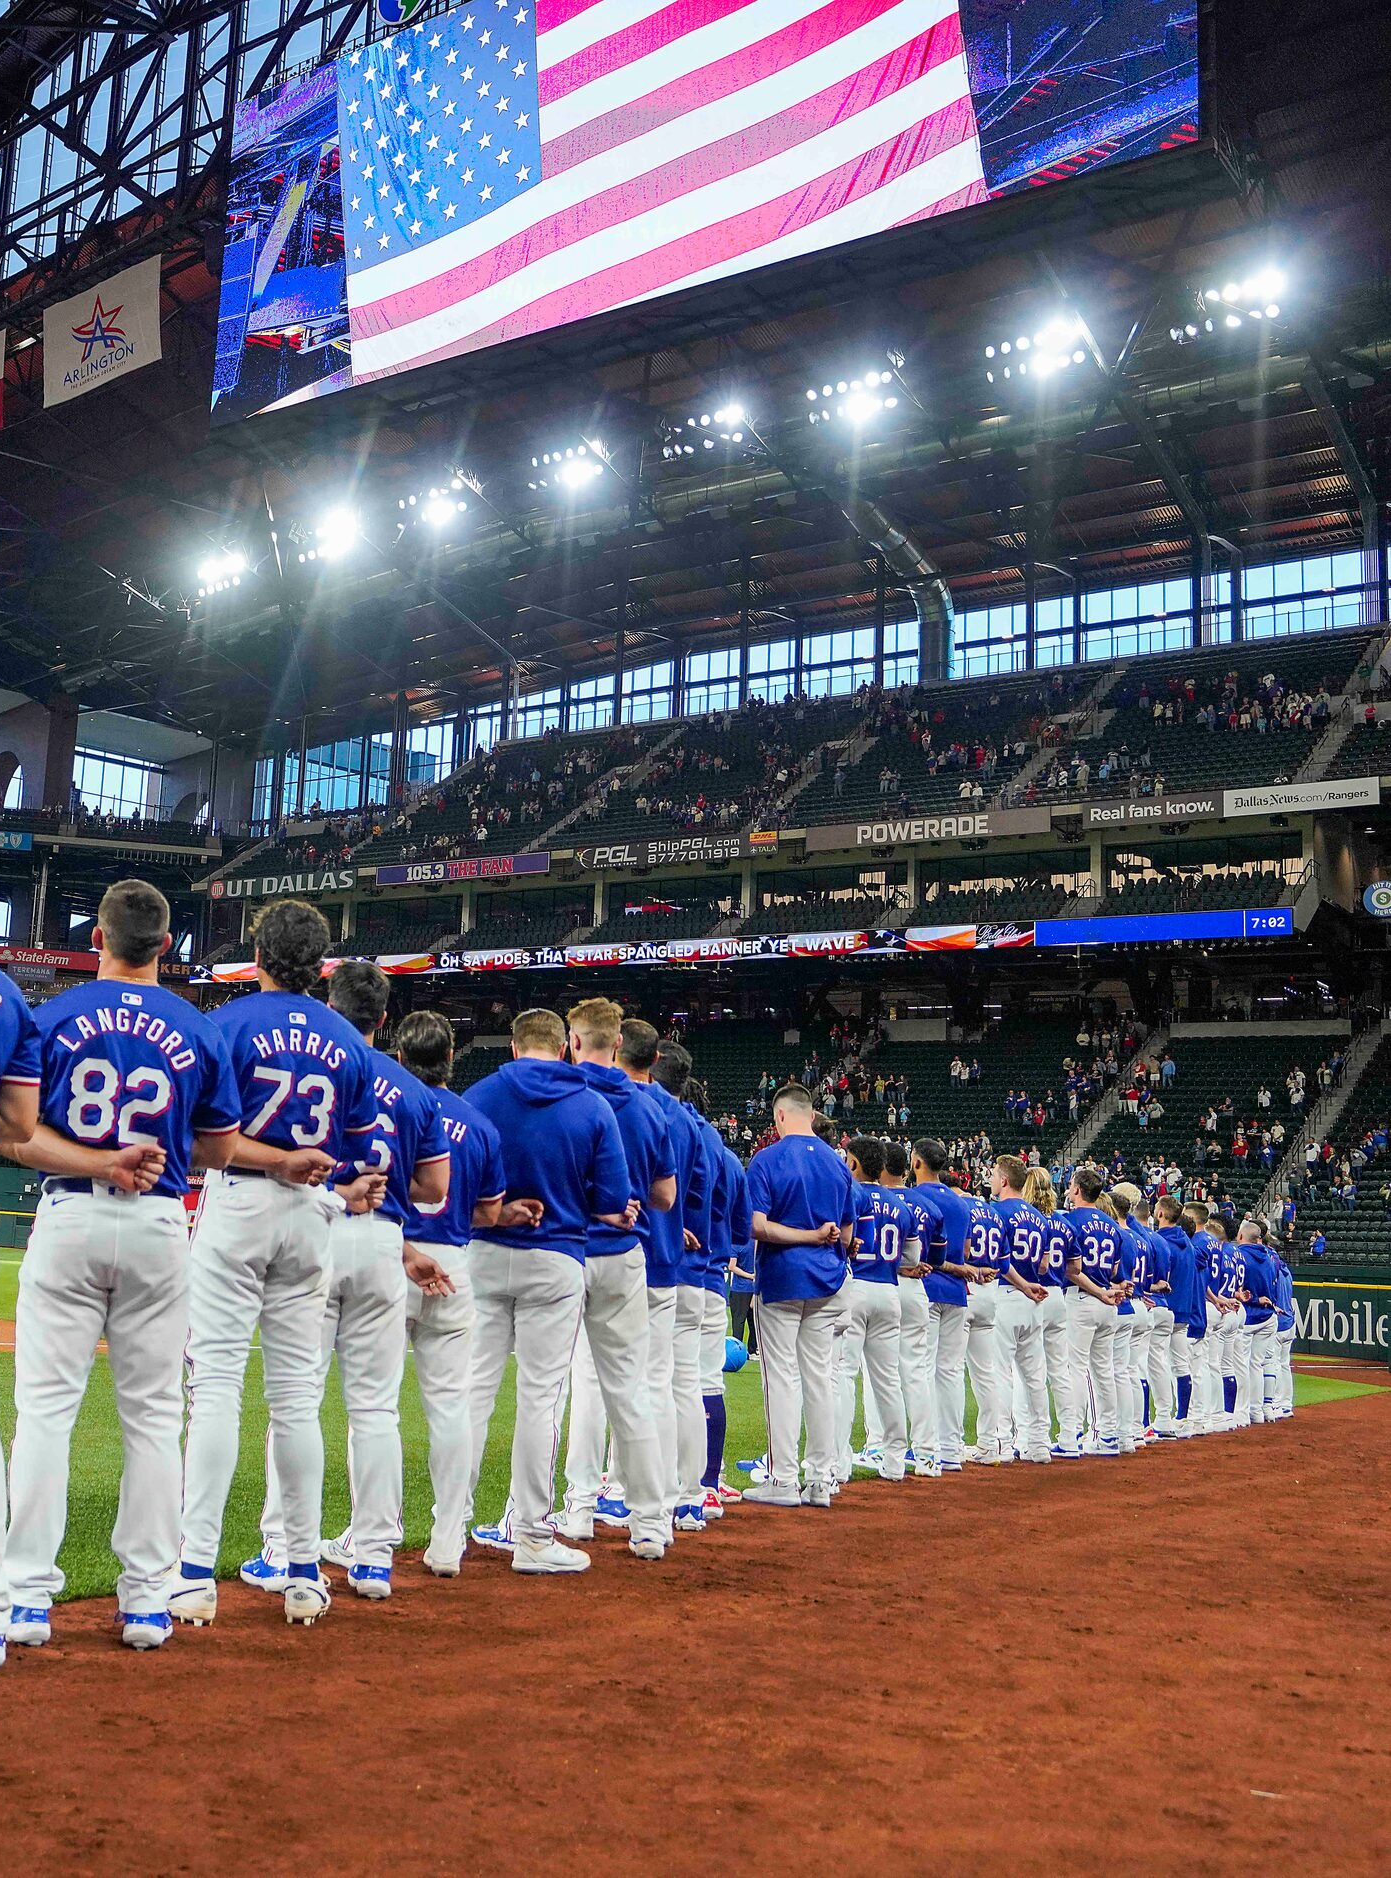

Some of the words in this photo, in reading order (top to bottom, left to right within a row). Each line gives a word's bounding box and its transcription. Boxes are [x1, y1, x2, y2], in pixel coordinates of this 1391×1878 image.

[63, 343, 134, 386] ARLINGTON
[1090, 805, 1124, 822] Real
[1127, 803, 1162, 819] fans
[1166, 800, 1214, 815] know.
[857, 814, 989, 844] POWERADE
[593, 845, 638, 865] PGL
[647, 847, 740, 864] 877.701.1919
[648, 837, 740, 853] ShipPGL.com
[226, 878, 257, 897] UT
[262, 870, 353, 895] DALLAS
[406, 863, 444, 882] 105.3
[447, 861, 477, 878] THE
[481, 857, 514, 875] FAN
[1251, 916, 1285, 929] 7:02
[440, 954, 459, 968] OH
[463, 953, 490, 966] SAY
[494, 951, 530, 965] DOES
[535, 949, 571, 963] THAT
[576, 944, 695, 962] STAR-SPANGLED
[700, 941, 761, 956] BANNER
[768, 938, 797, 953] YET
[806, 935, 855, 950] WAVE
[12, 966, 51, 975] TEREMANA
[56, 1007, 196, 1073] LANGFORD
[252, 1027, 347, 1070] HARRIS
[67, 1057, 173, 1147] 82
[243, 1065, 336, 1148] 73
[872, 1201, 900, 1219] RAN
[1009, 1209, 1045, 1232] SAMPSON
[970, 1224, 1001, 1260] 36
[1081, 1220, 1116, 1237] CARTER
[1012, 1228, 1042, 1262] 50
[1082, 1236, 1115, 1269] 32
[1291, 1297, 1389, 1347] Mbile
